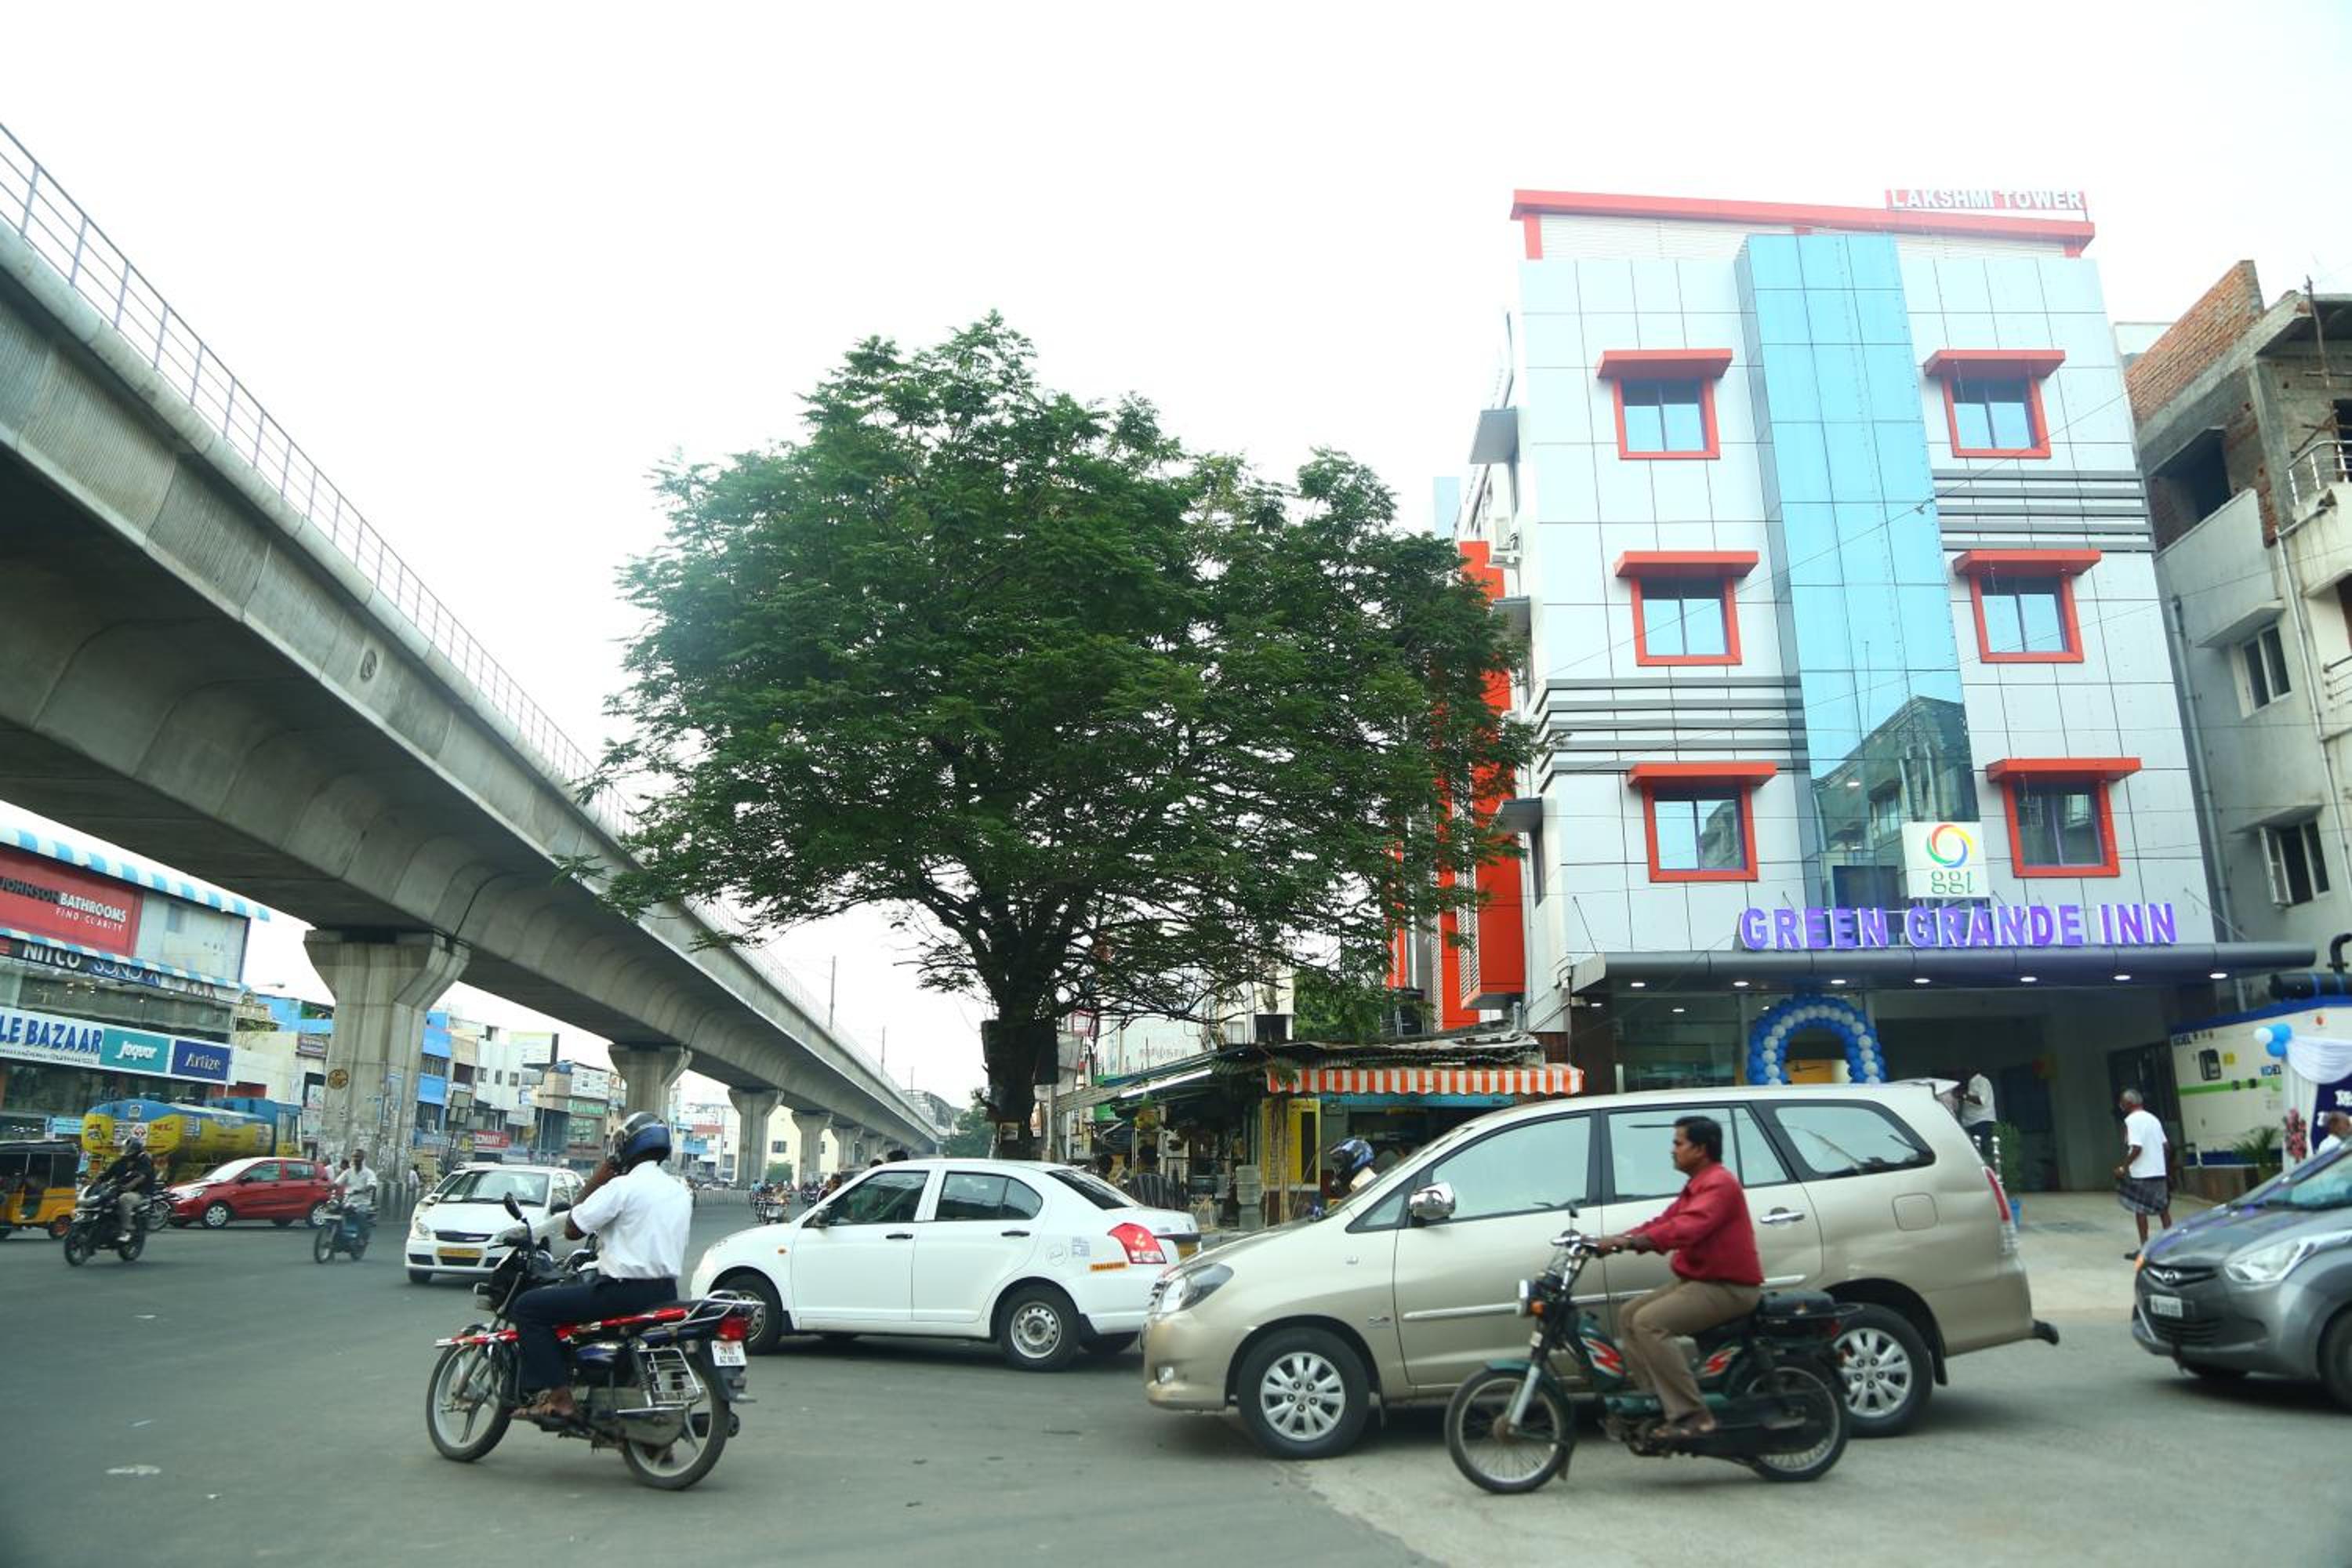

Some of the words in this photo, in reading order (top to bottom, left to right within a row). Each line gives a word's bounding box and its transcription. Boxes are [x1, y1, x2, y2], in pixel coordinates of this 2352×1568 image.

[1891, 189, 1995, 209] LAKSHMI
[1998, 191, 2085, 211] TOWER
[60, 892, 126, 923] BATHROOMS
[1739, 907, 1889, 951] GREEN
[1904, 905, 2083, 948] GRANDE
[2096, 902, 2177, 946] INN
[25, 1019, 103, 1054] BAZAAR
[184, 1053, 220, 1070] Artize
